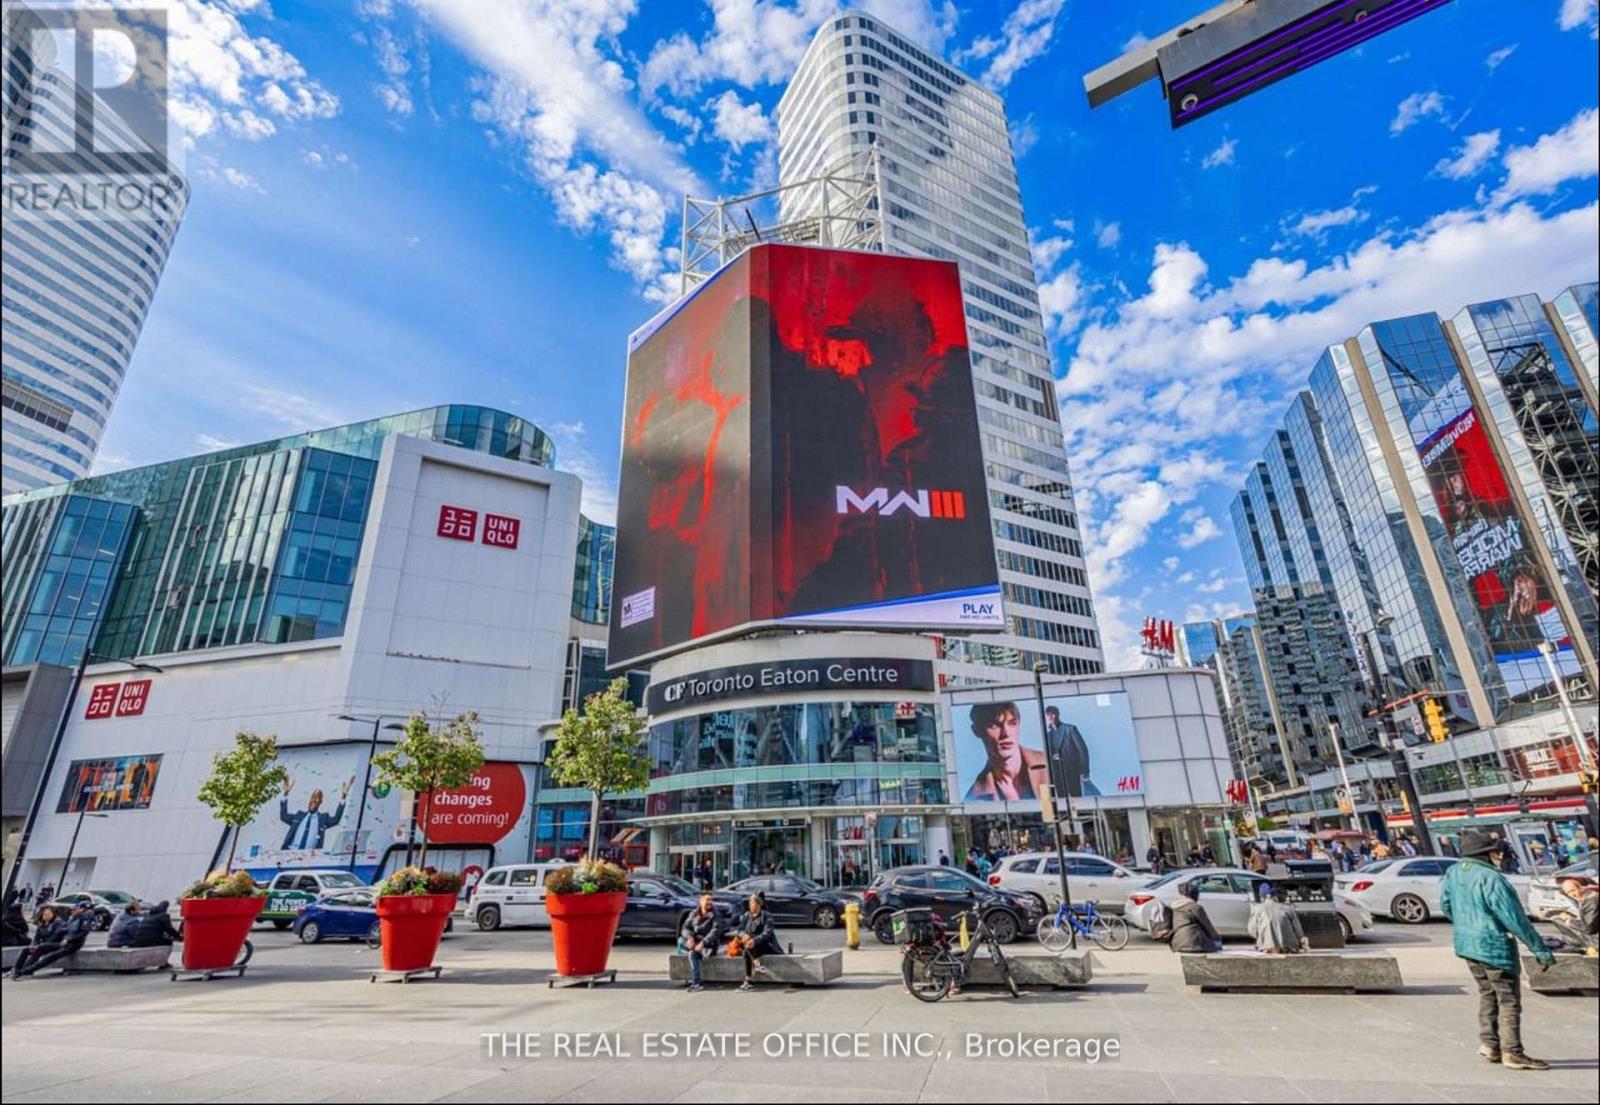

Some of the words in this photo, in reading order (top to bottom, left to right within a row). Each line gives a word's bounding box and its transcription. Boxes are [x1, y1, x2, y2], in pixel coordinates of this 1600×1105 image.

[488, 517, 514, 532] UNI
[487, 530, 515, 544] QLO
[963, 603, 994, 614] PLAY
[664, 682, 686, 702] CF
[688, 672, 755, 697] Toronto
[761, 668, 820, 686] Eaton
[826, 664, 899, 682] Centre
[124, 684, 145, 698] UNI
[119, 698, 142, 714] QLO
[1117, 776, 1140, 791] H&M
[434, 791, 492, 808] changes
[431, 813, 453, 824] are
[457, 812, 509, 828] coming!
